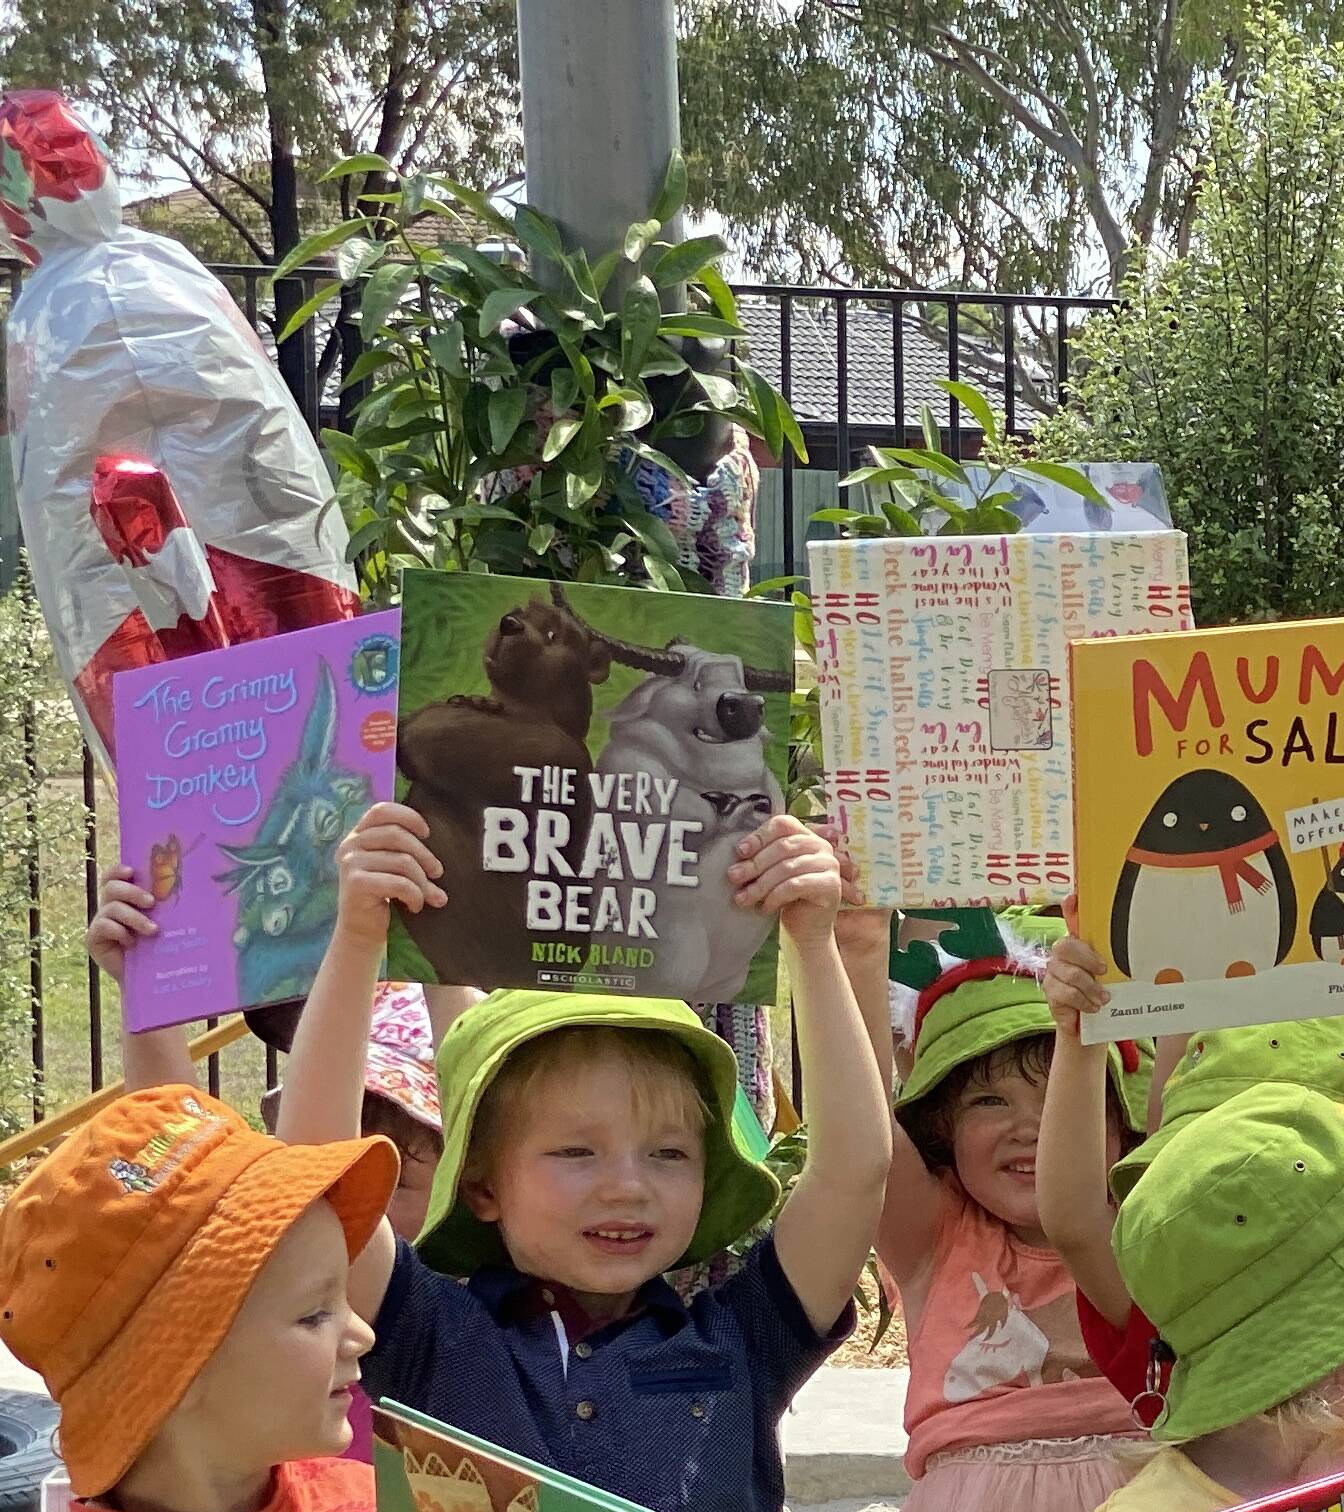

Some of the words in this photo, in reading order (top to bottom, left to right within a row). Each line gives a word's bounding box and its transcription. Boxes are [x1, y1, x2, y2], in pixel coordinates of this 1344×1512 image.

[134, 677, 193, 723] The
[202, 668, 298, 713] Grinny
[164, 717, 267, 760] Granny
[1177, 734, 1234, 759] FOR
[146, 764, 261, 825] Donkey
[513, 766, 577, 805] THE
[588, 771, 679, 815] VERY
[483, 807, 703, 886] BRAVE
[527, 880, 659, 939] BEAR
[531, 942, 582, 964] NICK
[589, 944, 655, 969] BLAND
[552, 974, 634, 987] SCHOLASTIC
[1110, 1004, 1144, 1018] Zanni
[1147, 1001, 1185, 1015] Louise
